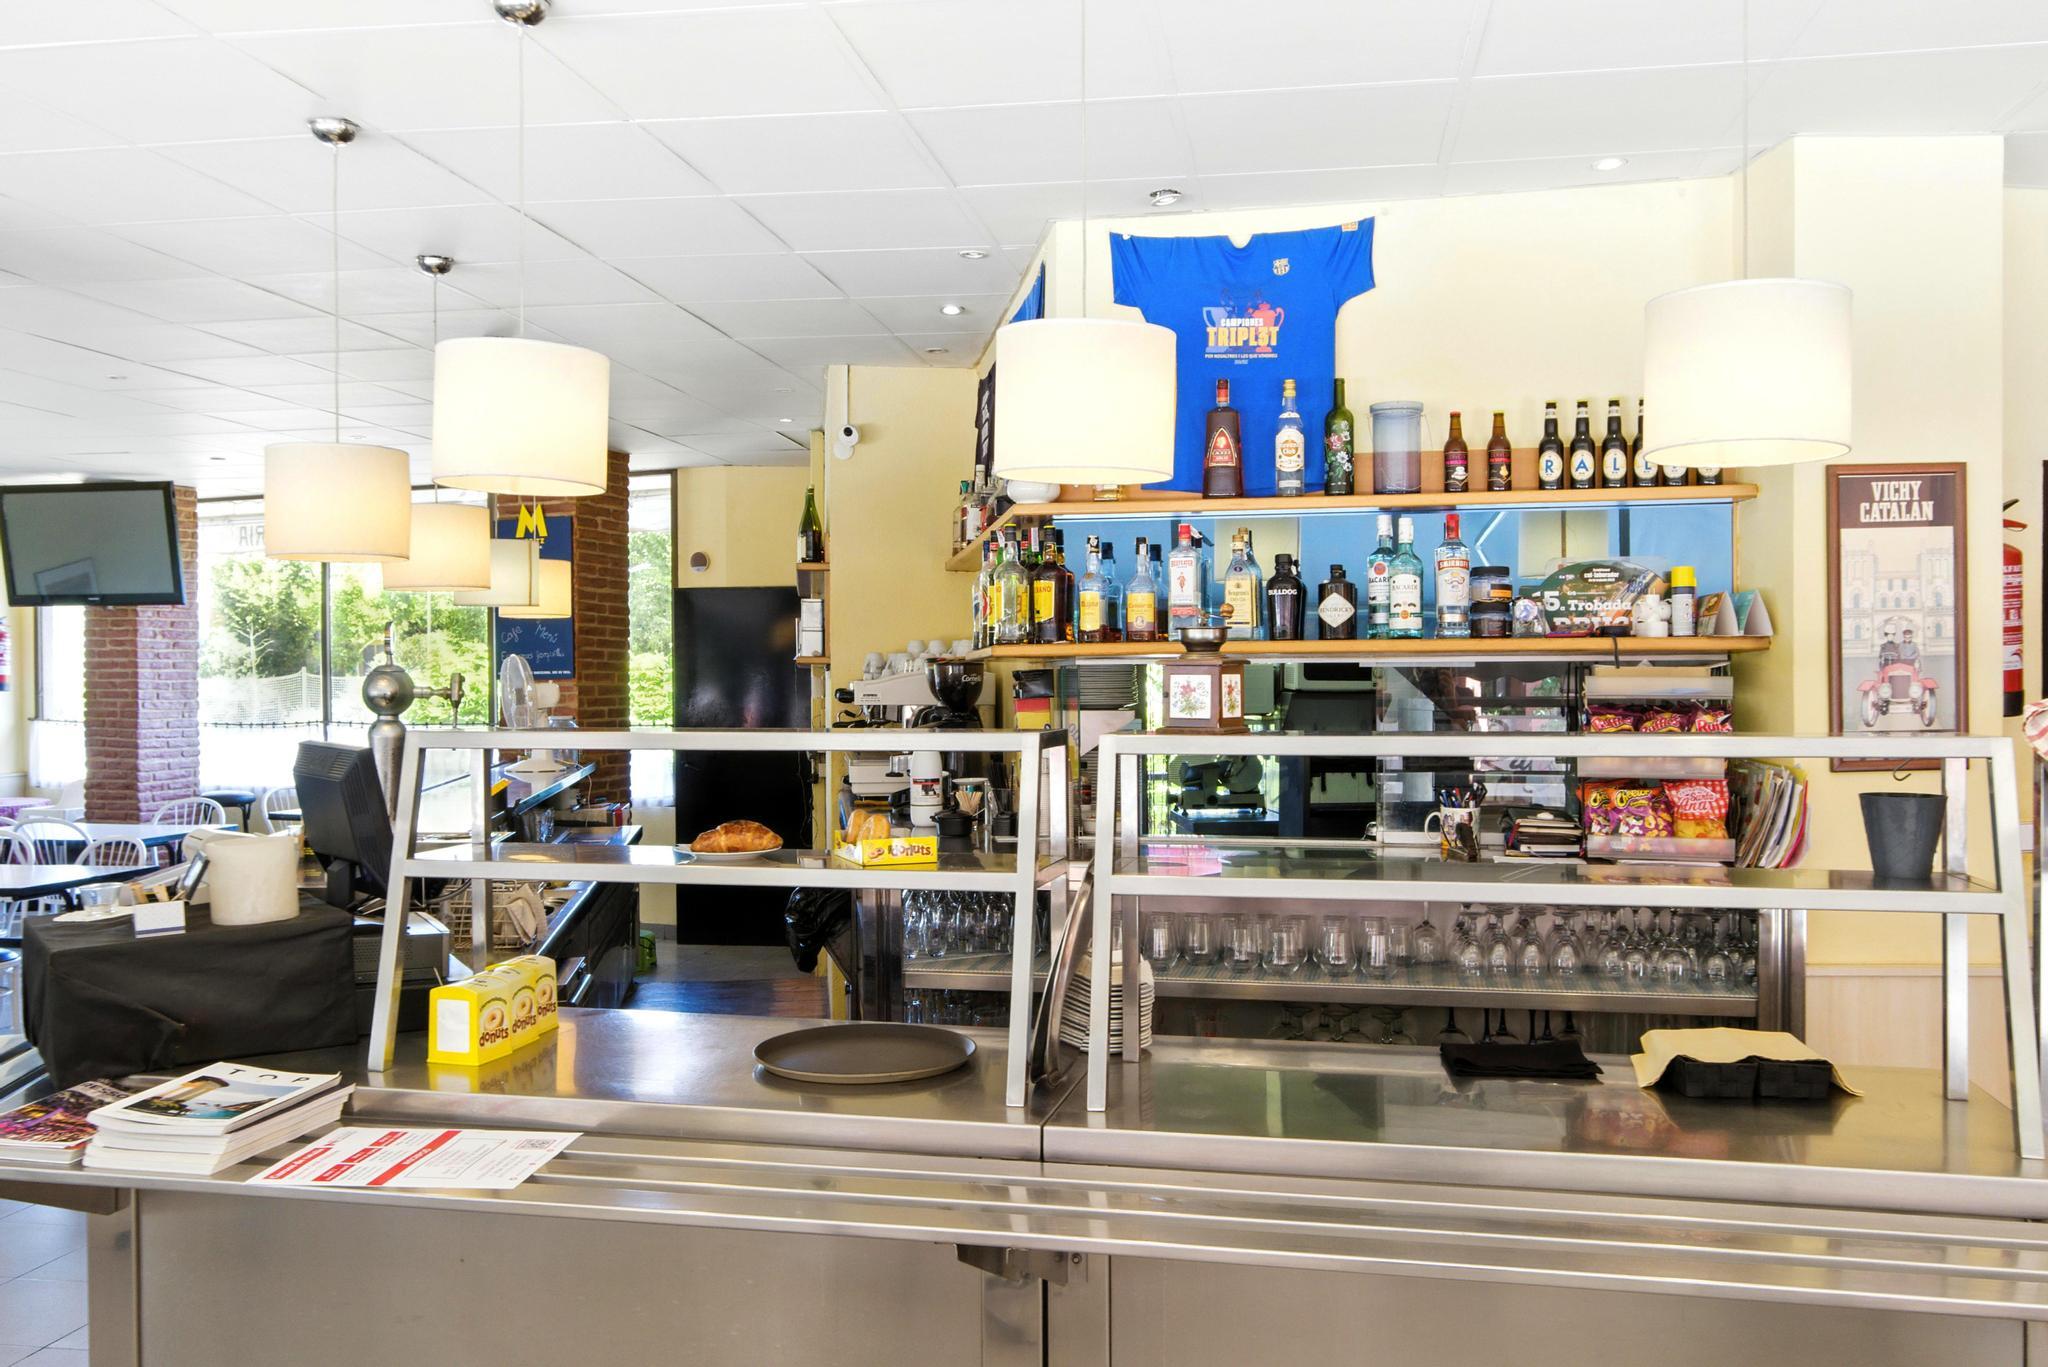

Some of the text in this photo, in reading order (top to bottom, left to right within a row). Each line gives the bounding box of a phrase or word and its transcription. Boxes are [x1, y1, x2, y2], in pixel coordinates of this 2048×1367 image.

[1545, 460, 1554, 473] R
[1575, 459, 1589, 472] A
[1613, 457, 1620, 471] L
[1871, 481, 1922, 501] VICHY
[1860, 501, 1934, 522] CATALAN
[1567, 599, 1632, 611] Trobada
[537, 1003, 557, 1016] onuts
[512, 1015, 537, 1033] donuts
[479, 1027, 509, 1047] donuts
